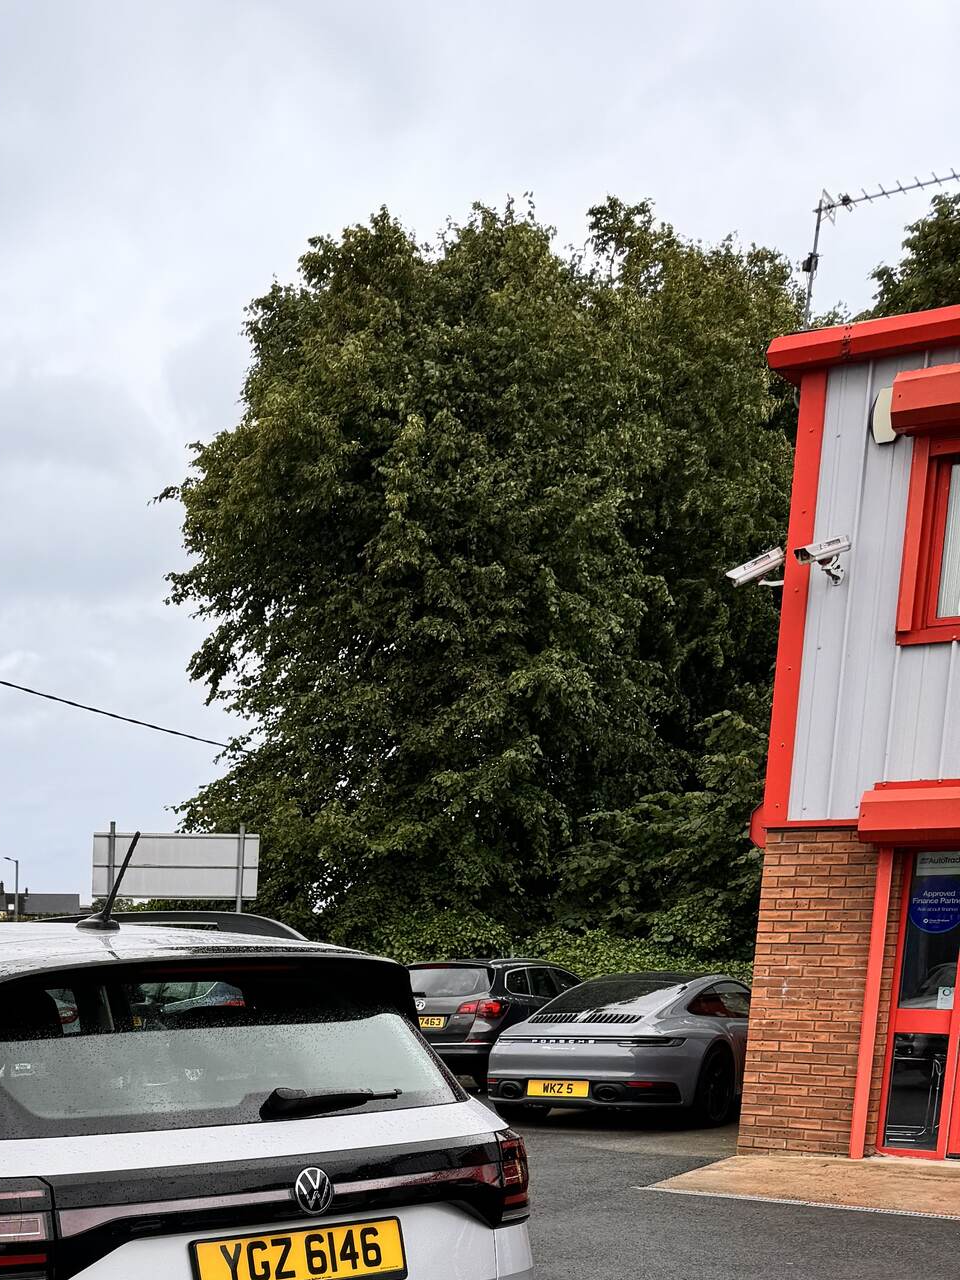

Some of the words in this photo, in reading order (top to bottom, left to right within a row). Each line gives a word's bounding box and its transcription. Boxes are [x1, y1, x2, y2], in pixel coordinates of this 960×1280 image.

[923, 890, 956, 898] Approved
[419, 1017, 442, 1026] 7463
[542, 1083, 564, 1094] WKZ
[566, 1082, 573, 1094] 5
[304, 1226, 382, 1275] 6146
